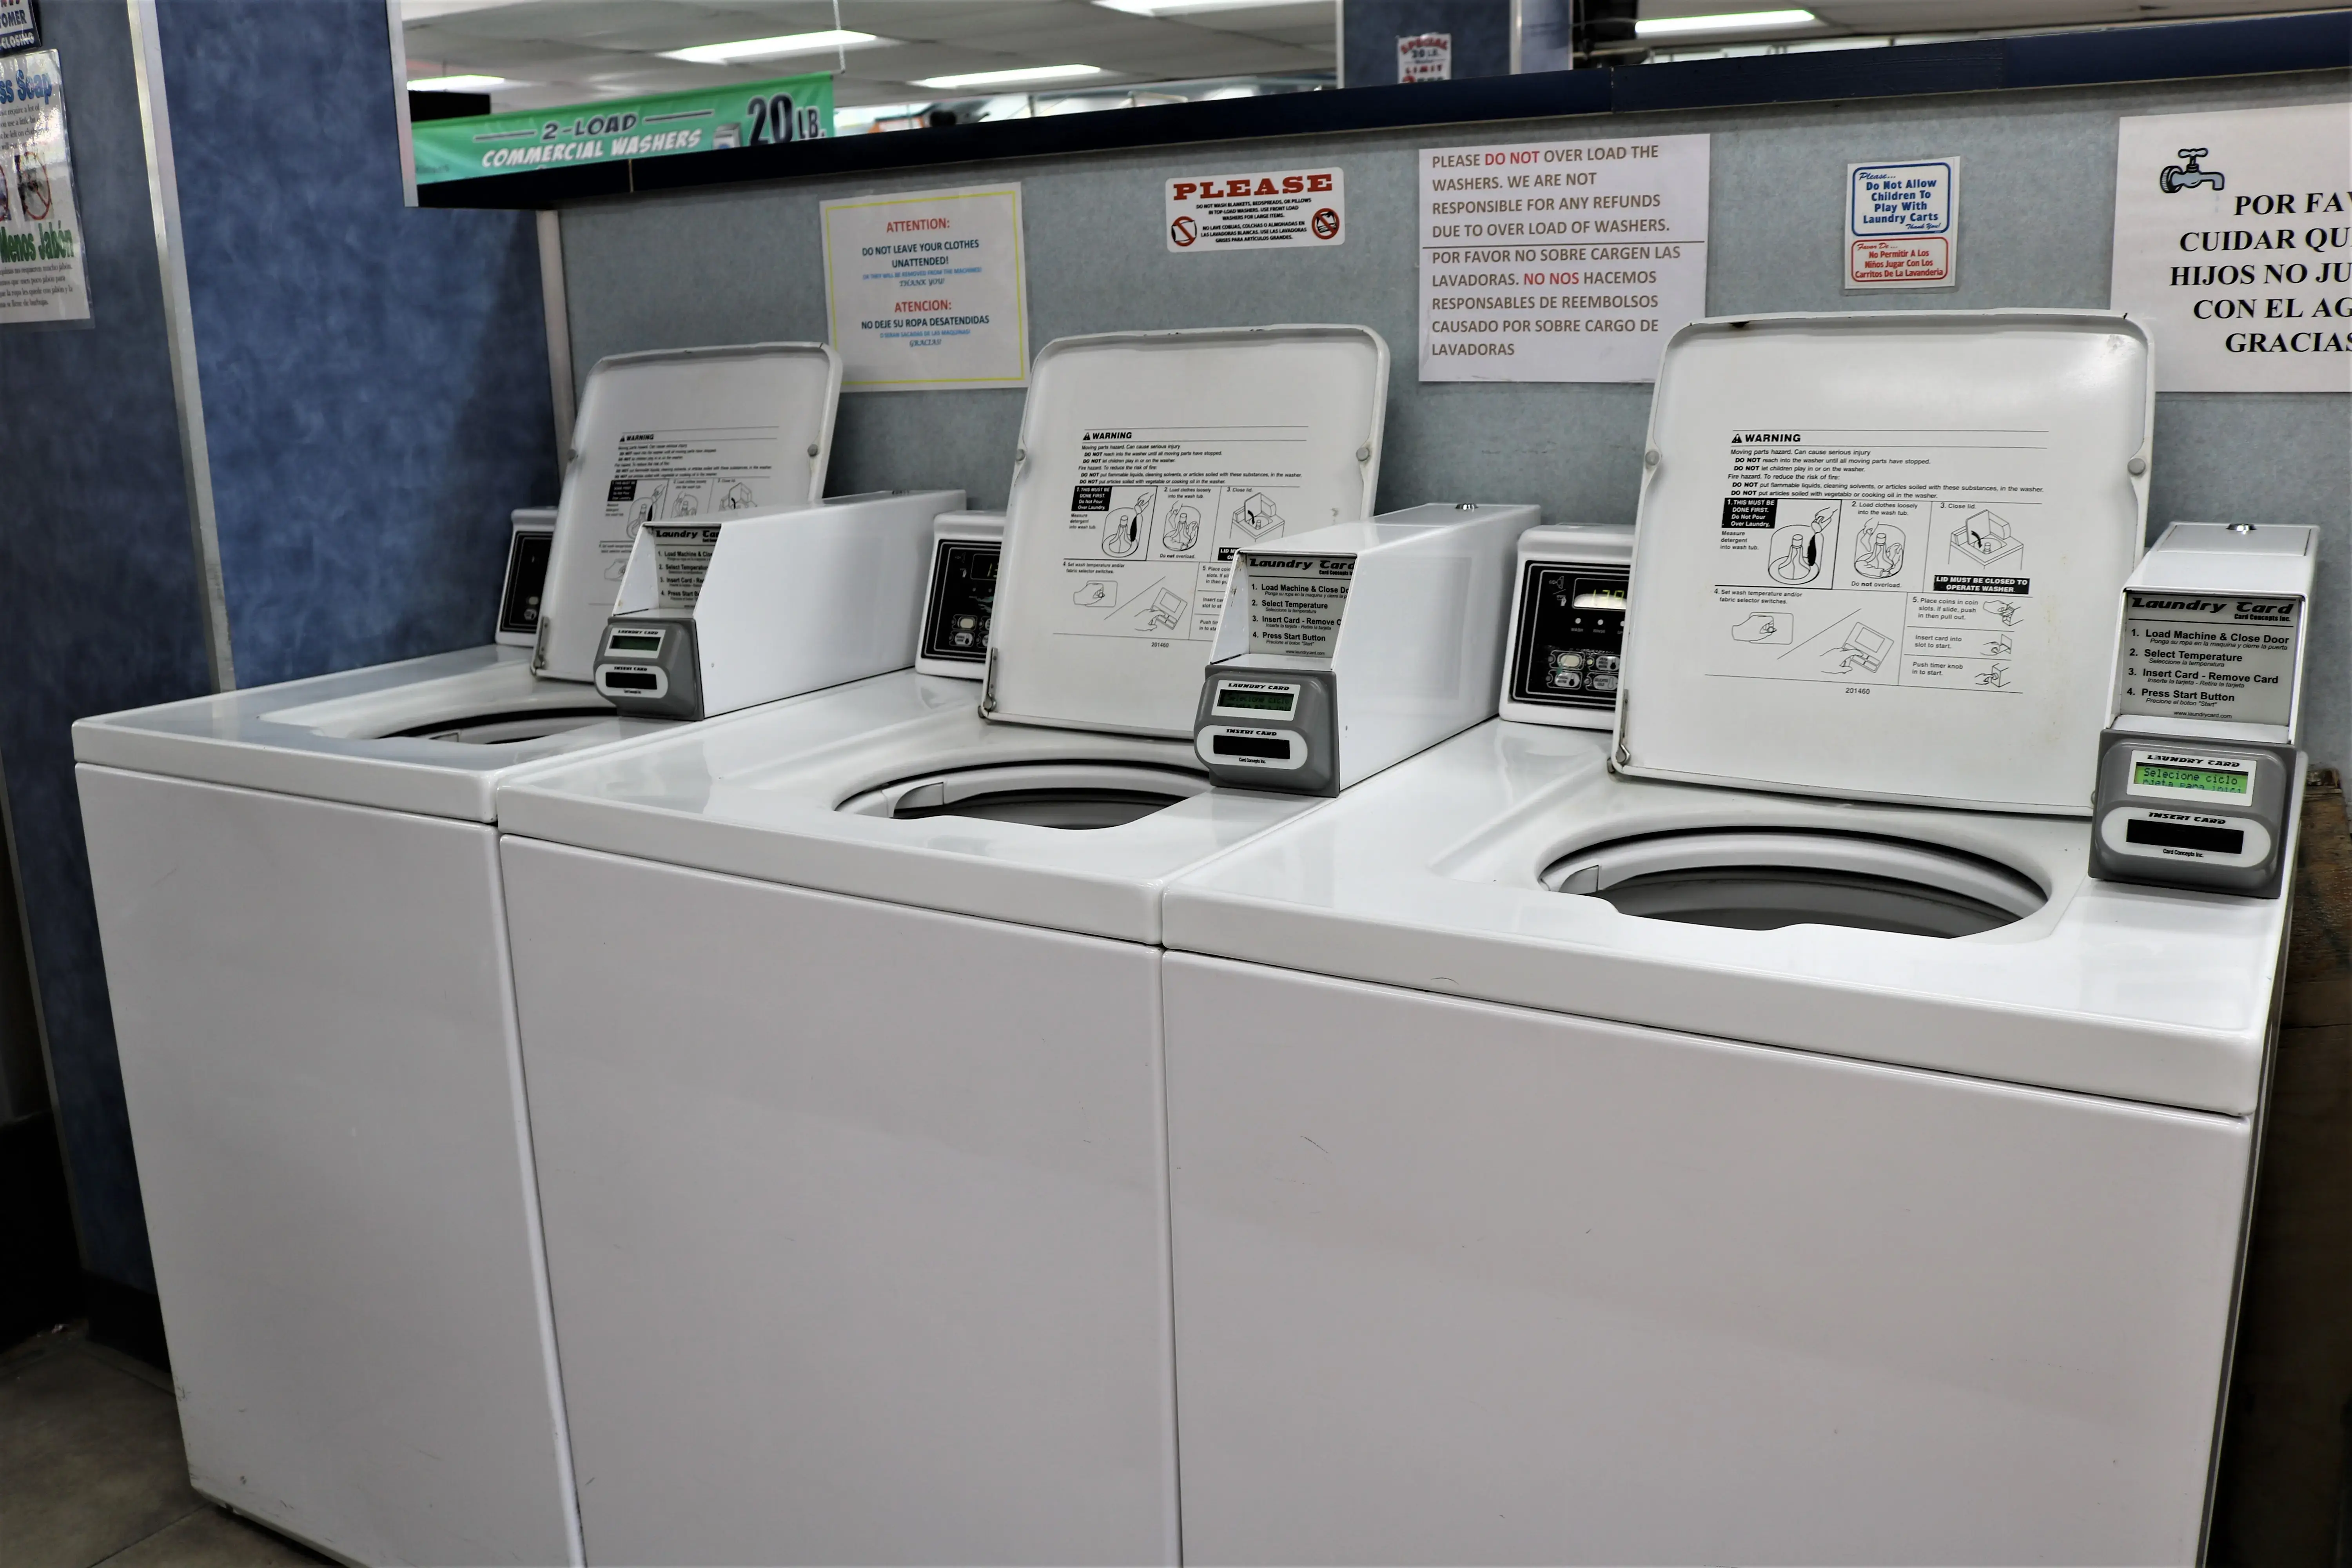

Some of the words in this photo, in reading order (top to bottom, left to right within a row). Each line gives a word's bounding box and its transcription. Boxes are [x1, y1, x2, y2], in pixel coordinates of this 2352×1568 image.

[541, 113, 639, 141] 2-LOAD
[746, 94, 793, 147] 20
[481, 140, 603, 168] COMMERCIAL
[610, 129, 702, 157] WASHERS
[1433, 154, 1480, 168] PLEASE
[1485, 152, 1505, 165] DO
[1510, 151, 1540, 164] NOT
[1544, 149, 1582, 162] OVER
[1588, 147, 1626, 160] LOAD
[1631, 145, 1658, 158] THE
[1173, 174, 1332, 200] PLEASE
[1432, 176, 1502, 191] WASHERS.
[1507, 175, 1529, 188] WE
[1534, 174, 1561, 187] ARE
[1566, 172, 1597, 185] NOT
[1866, 182, 1879, 191] Do
[1884, 181, 1902, 189] Not
[1906, 179, 1936, 188] Allow
[1871, 191, 1915, 201] Children
[1920, 190, 1931, 199] To
[2234, 194, 2294, 215] POR
[2306, 191, 2352, 212] FA
[1433, 199, 1522, 214] RESPONSIBLE
[1527, 198, 1554, 211] FOR
[1559, 197, 1588, 210] ANY
[1593, 194, 1660, 209] REFUNDS
[1875, 203, 1897, 213] Play
[1902, 201, 1927, 211] With
[887, 218, 949, 232] ATTENTION:
[1863, 214, 1906, 224] Laundry
[1910, 212, 1938, 221] Carts
[1433, 225, 1460, 238] DUE
[1464, 224, 1483, 236] TO
[1487, 223, 1524, 236] OVER
[1529, 222, 1567, 234] LOAD
[1572, 221, 1590, 233] OF
[1595, 219, 1669, 232] WASHERS.
[2180, 229, 2294, 251] CUIDAR
[2305, 227, 2352, 252] QU
[862, 247, 873, 256] DO
[875, 245, 891, 254] NOT
[893, 244, 917, 254] LEAVE
[919, 242, 942, 251] YOUR
[944, 239, 979, 250] CLOTHES
[1433, 252, 1460, 263] POR
[1465, 250, 1510, 263] FAVOR
[1515, 249, 1536, 261] NO
[1541, 248, 1586, 261] SOBRE
[1591, 247, 1650, 260] CARGEN
[1655, 246, 1680, 258] LAS
[1880, 250, 1908, 258] Permitir
[892, 256, 948, 268] UNATTENDED!
[1885, 260, 1904, 269] Jugar
[1433, 273, 1519, 287] LAVADORAS.
[1524, 273, 1544, 285] NO
[1550, 272, 1579, 285] NOS
[1584, 271, 1656, 284] HACEMOS
[1855, 270, 1883, 279] Carritos
[1905, 268, 1943, 276] Lavanderia
[2170, 265, 2254, 285] HIJOS
[2265, 264, 2307, 283] NO
[895, 299, 951, 312] ATENCION:
[1432, 296, 1535, 310] RESPONSABLES
[1540, 296, 1557, 308] DE
[1562, 295, 1658, 308] REEMBOLSOS
[2194, 299, 2256, 319] CON
[2266, 298, 2303, 318] EL
[861, 321, 873, 329] NO
[875, 320, 891, 328] DEJE
[906, 318, 927, 327] ROPA
[929, 315, 989, 326] DESATENDIDAS
[1432, 320, 1498, 332] CAUSADO
[1503, 320, 1530, 332] POR
[1535, 320, 1580, 332] SOBRE
[1585, 319, 1635, 332] CARGO
[1641, 319, 1658, 331] DE
[1432, 343, 1514, 355] LAVADORAS
[2132, 598, 2227, 613] Laundry
[2236, 602, 2294, 614] Card
[2146, 629, 2171, 638] Load
[2174, 630, 2216, 640] Machine
[2230, 633, 2260, 642] Close
[2264, 635, 2289, 644] Door
[2144, 649, 2175, 658] Select
[2178, 651, 2242, 661] Temperature
[2143, 668, 2171, 677] Insert
[2175, 670, 2198, 679] Card
[2209, 672, 2250, 682] Remove
[2254, 675, 2278, 683] Card
[2142, 688, 2169, 697] Press
[2173, 690, 2197, 699] Start
[2200, 692, 2234, 701] Button
[2147, 755, 2204, 764] LAUNDRY
[2143, 769, 2199, 781] Selecione
[2206, 775, 2237, 785] ciclo
[2149, 812, 2190, 820] INSERT
